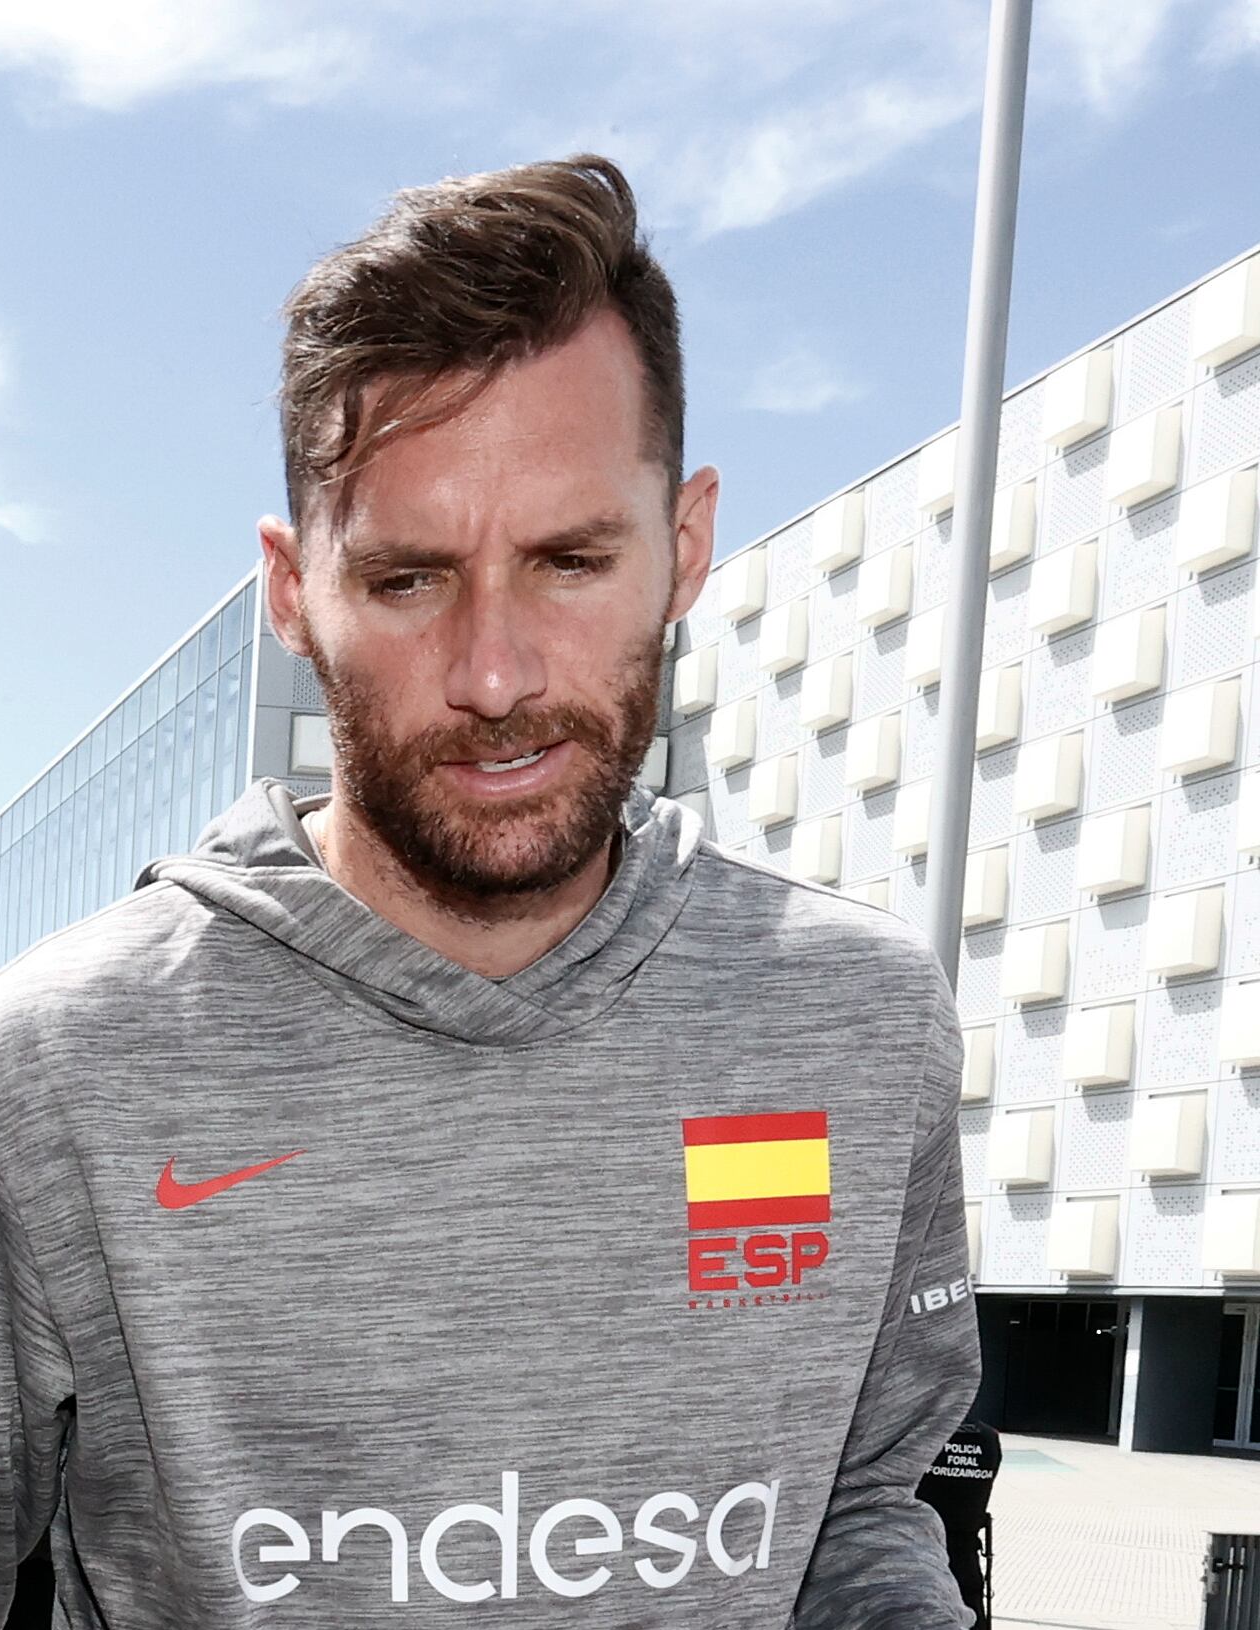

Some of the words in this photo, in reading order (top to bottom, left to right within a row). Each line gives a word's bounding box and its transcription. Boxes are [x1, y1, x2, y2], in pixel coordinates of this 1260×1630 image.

[688, 1231, 829, 1291] ESP
[947, 1455, 979, 1467] FORAL
[232, 1471, 781, 1603] endesa
